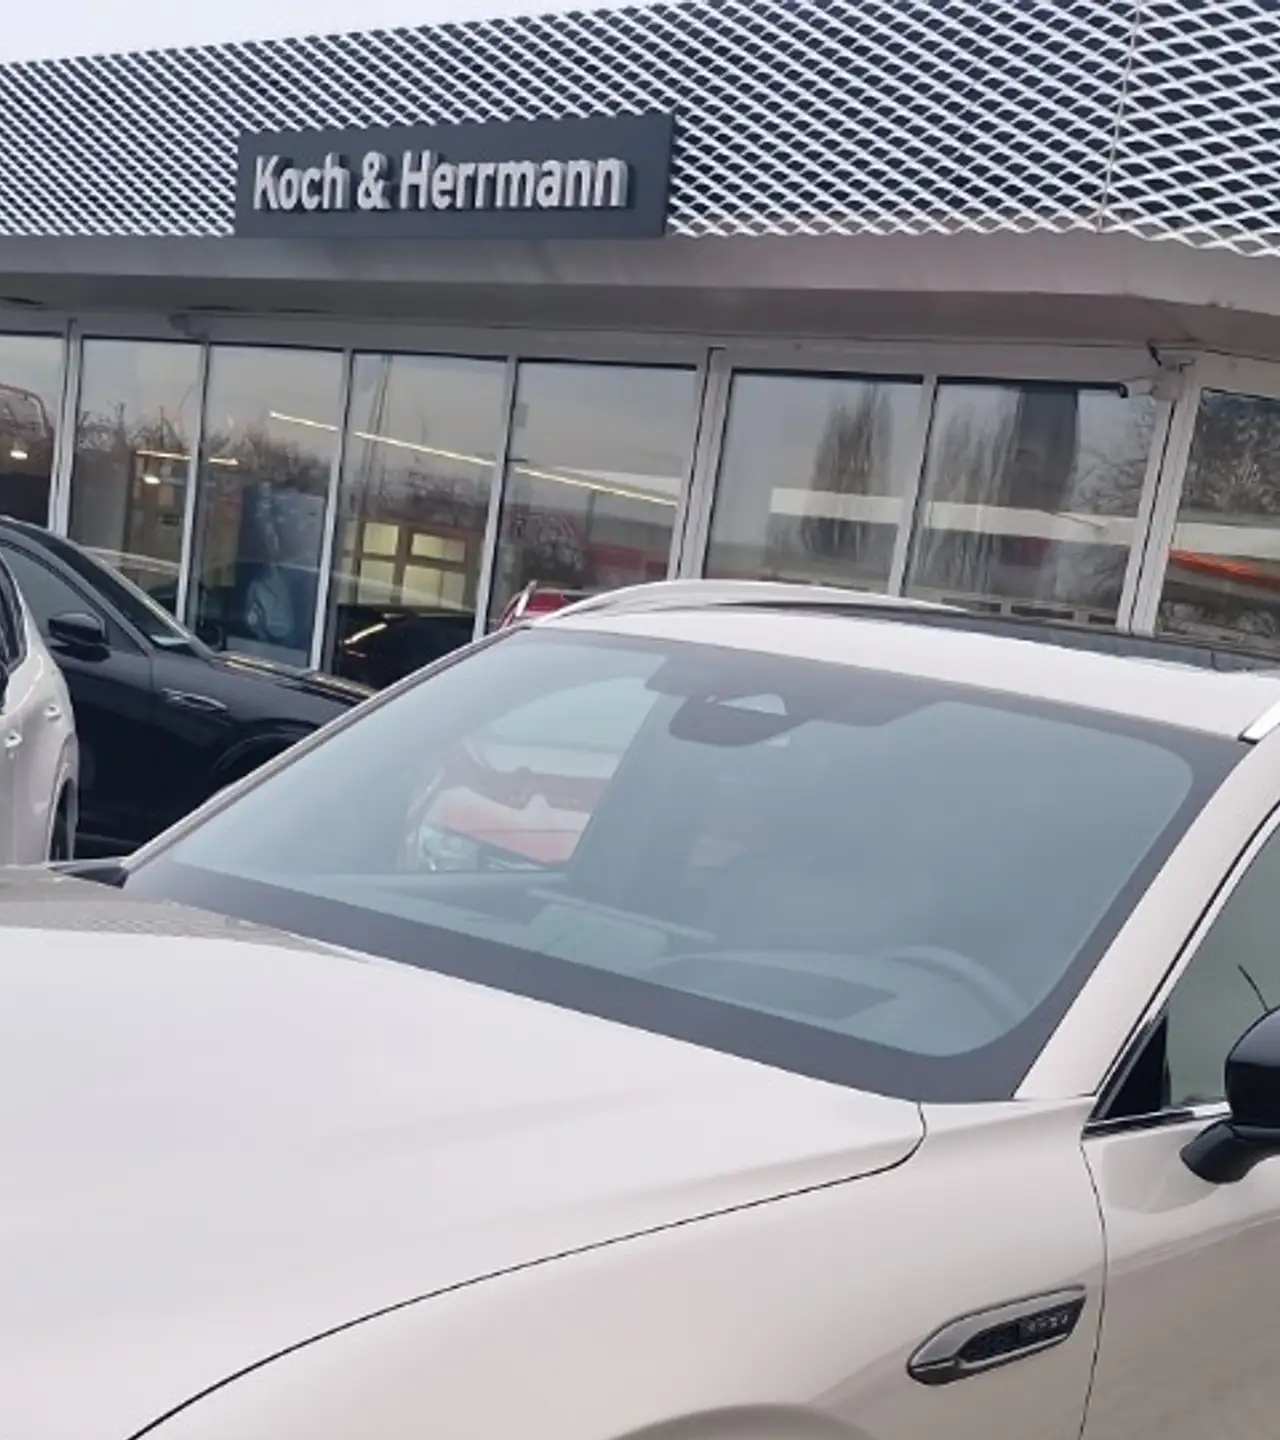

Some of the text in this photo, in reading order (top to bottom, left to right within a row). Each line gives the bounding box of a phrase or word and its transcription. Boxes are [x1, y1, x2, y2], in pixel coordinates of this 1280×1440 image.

[252, 149, 629, 210] Koch & Herrmann
